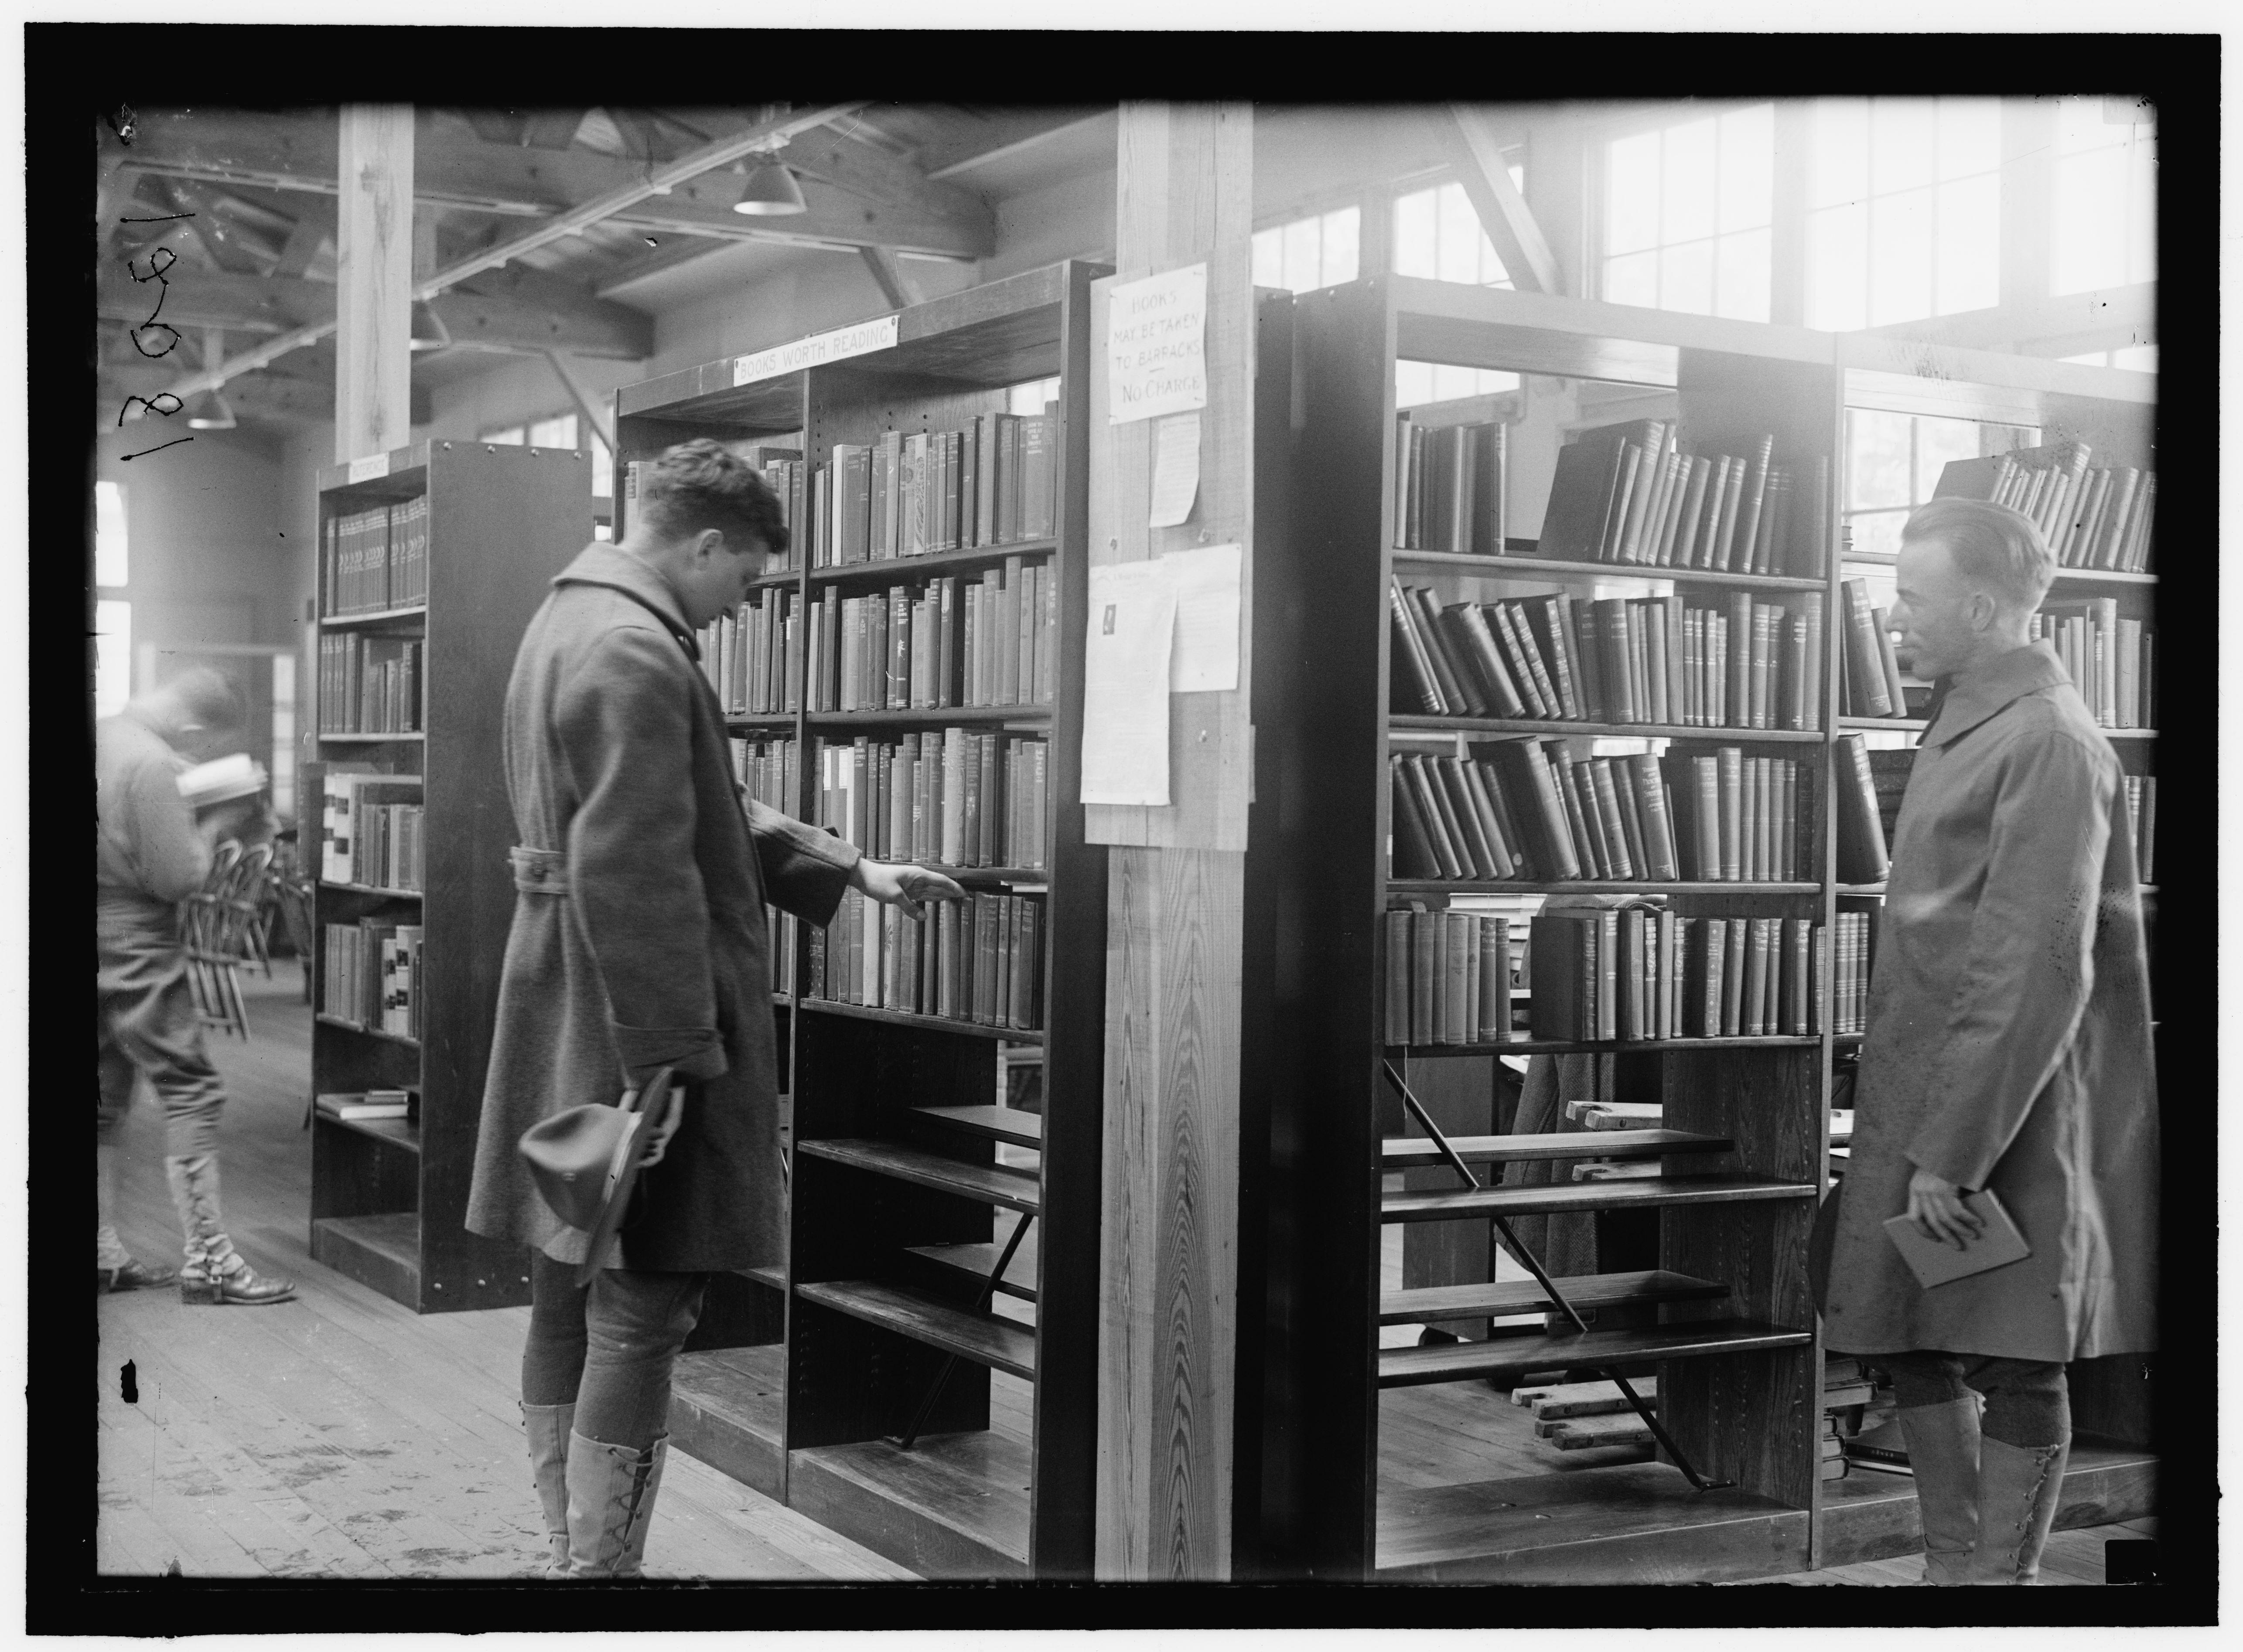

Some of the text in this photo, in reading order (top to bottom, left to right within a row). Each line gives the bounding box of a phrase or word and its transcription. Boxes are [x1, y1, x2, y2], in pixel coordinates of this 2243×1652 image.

[1132, 290, 1177, 314] BOOKS
[1113, 312, 1199, 344] MAY BE TAKEN
[740, 325, 888, 379] BOOKS WORTH READING
[1116, 339, 1200, 370] TO BARRACKS
[1145, 375, 1199, 399] CHARGE
